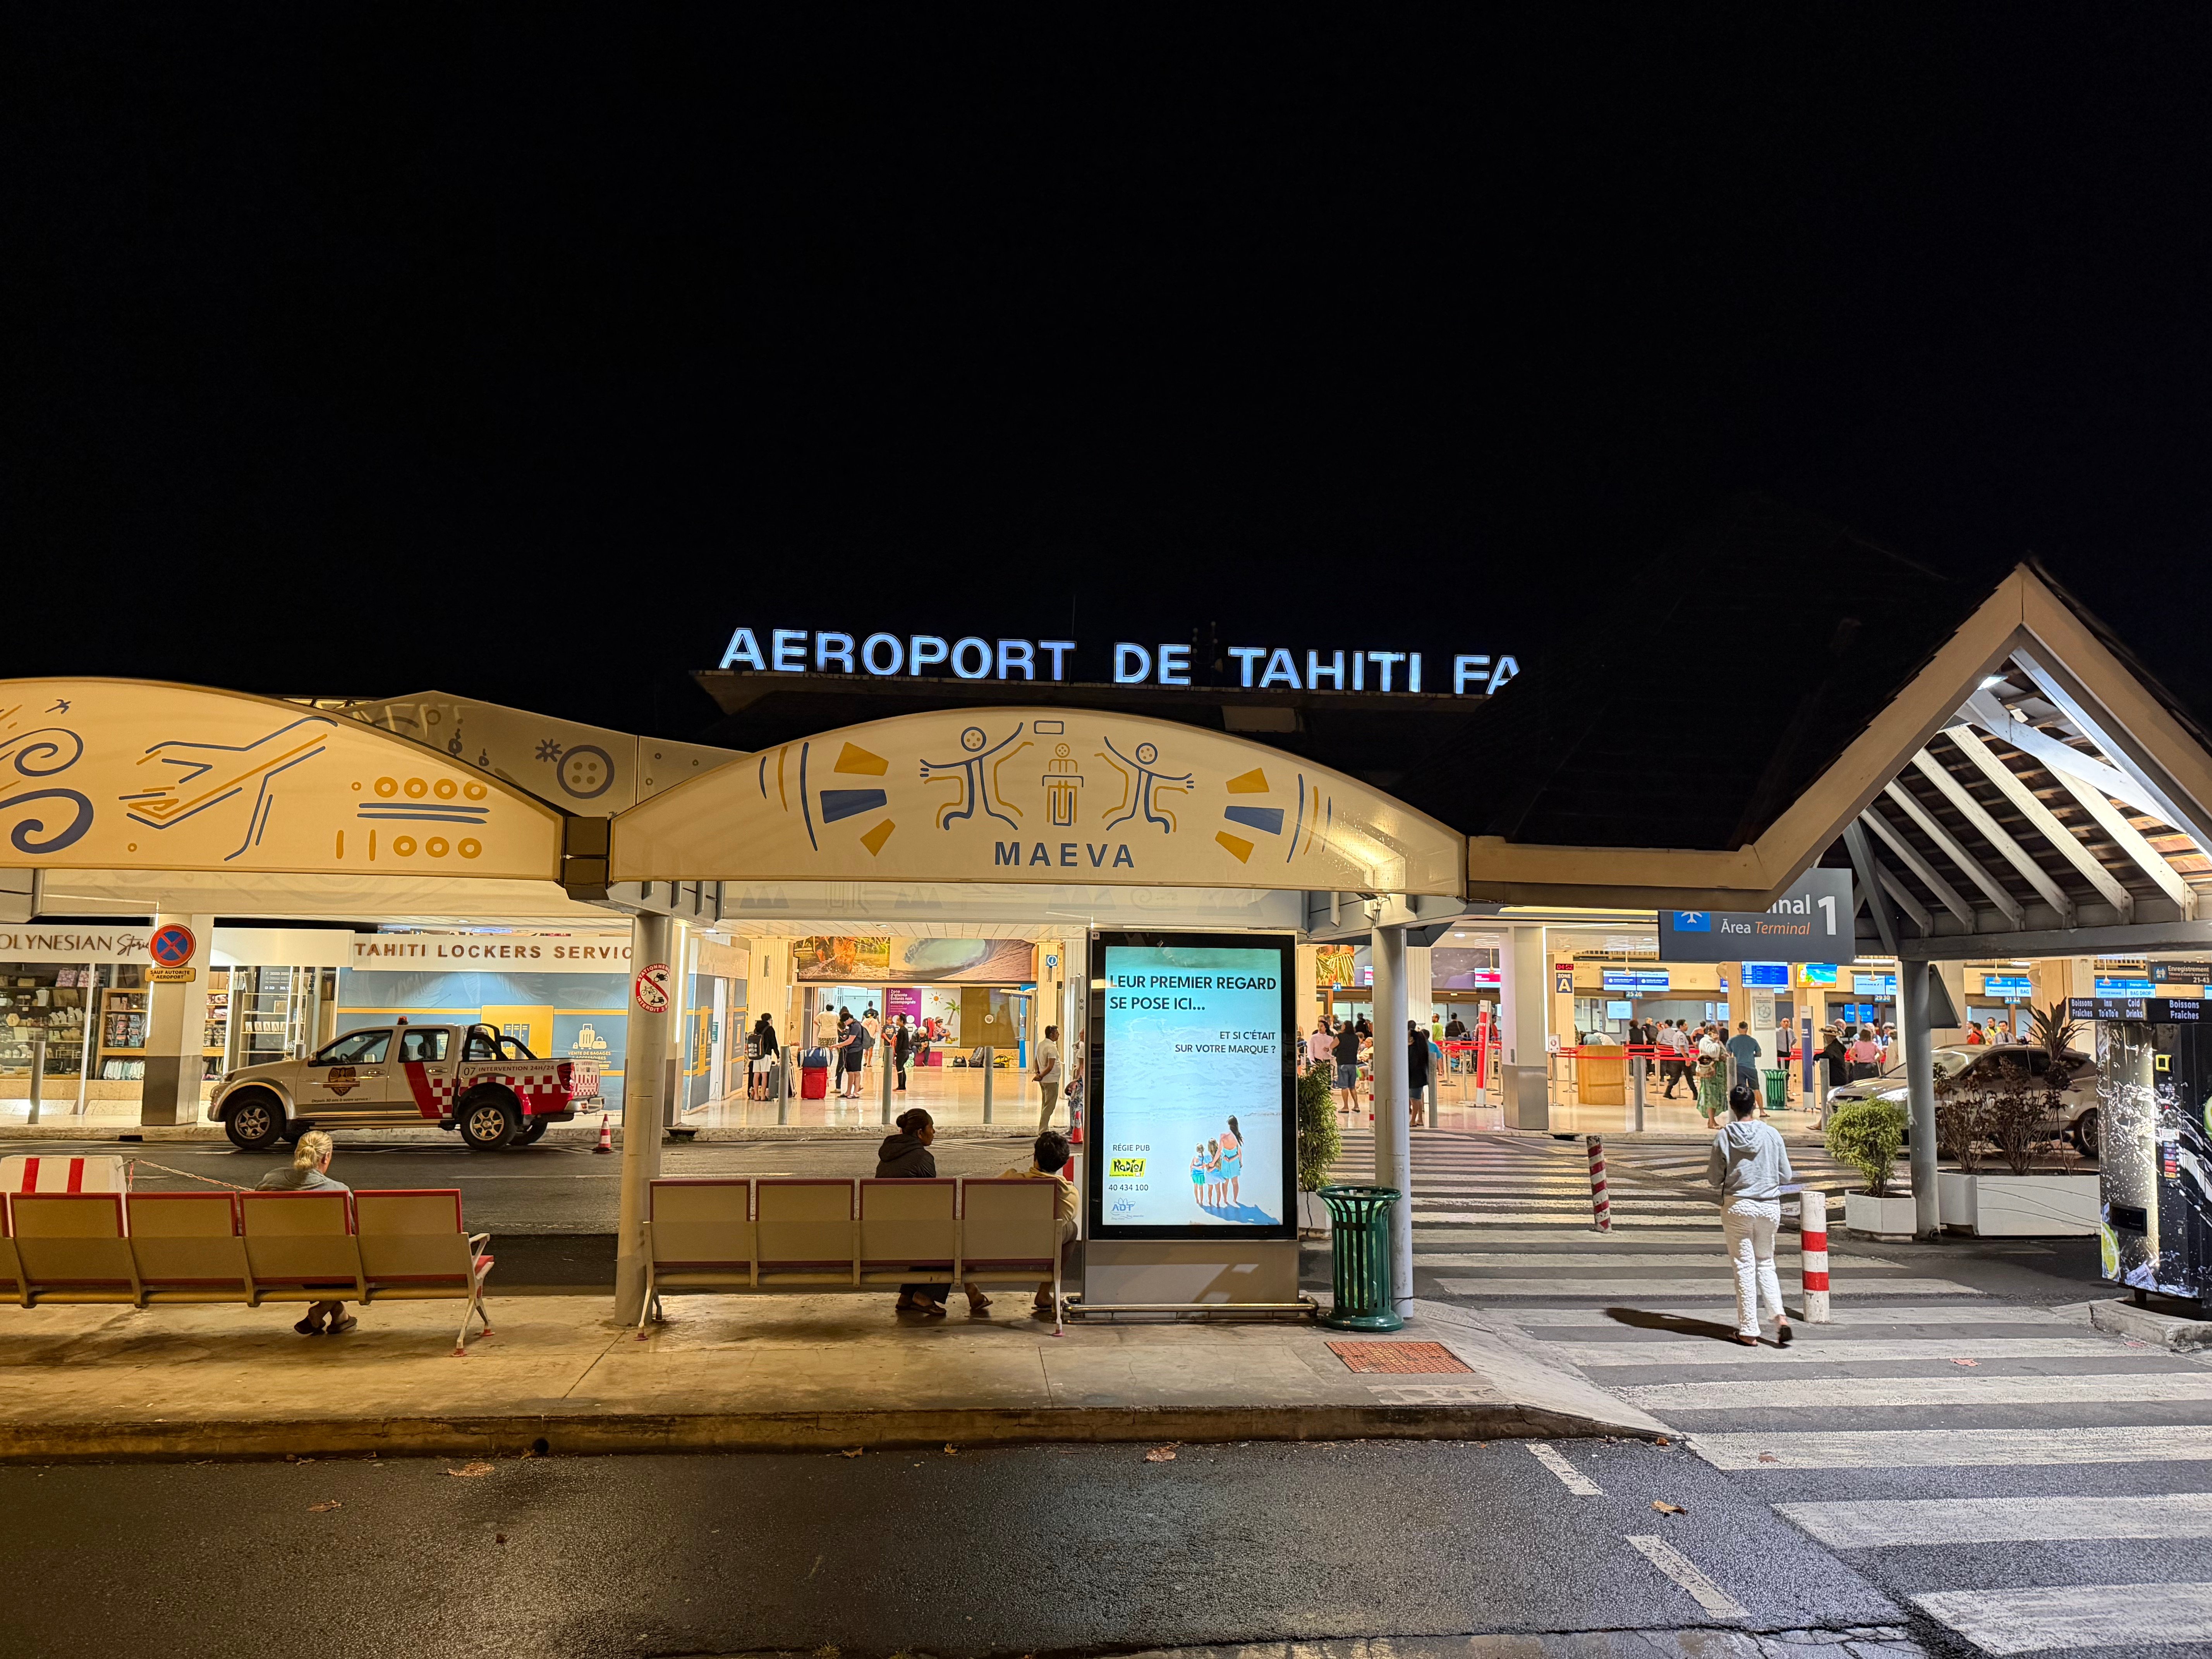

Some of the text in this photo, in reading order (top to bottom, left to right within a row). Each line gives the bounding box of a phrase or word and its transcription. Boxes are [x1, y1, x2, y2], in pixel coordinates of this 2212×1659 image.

[719, 627, 1520, 694] AEROPORT DE TAHITI FA
[995, 842, 1134, 867] MAEVA
[1818, 896, 1836, 935] 1
[1721, 919, 1810, 935] Ārea Terminal
[355, 943, 426, 957] TAHITI
[438, 945, 541, 958] LOCKERS
[1110, 975, 1276, 990] LEUR PREMIER REGARD
[1558, 979, 1571, 991] A
[637, 996, 659, 1012] INTERDIT
[1110, 996, 1205, 1010] SE POSE ICI...
[2072, 999, 2093, 1007] Boissons
[2128, 999, 2140, 1007] Cold
[2169, 1000, 2200, 1009] Boissons
[2072, 1008, 2093, 1017] Fraîches
[2126, 1009, 2143, 1018] Drinks
[2170, 1010, 2200, 1020] Fraîches
[1175, 1044, 1276, 1055] SUR VOTRE MARQUE ?
[464, 1068, 476, 1076] 07
